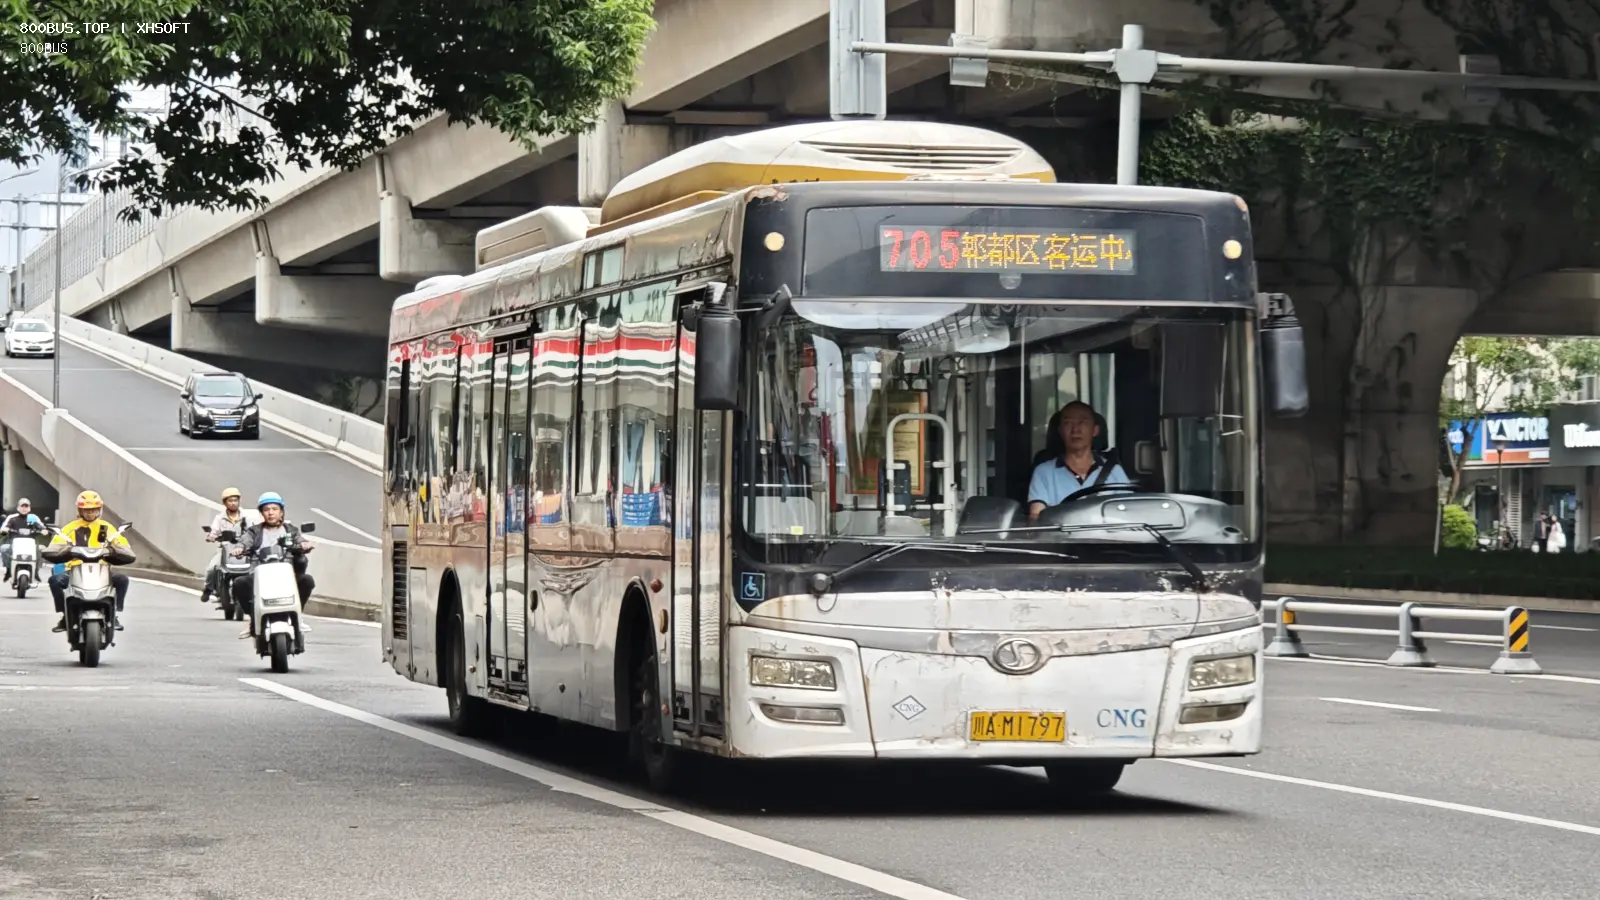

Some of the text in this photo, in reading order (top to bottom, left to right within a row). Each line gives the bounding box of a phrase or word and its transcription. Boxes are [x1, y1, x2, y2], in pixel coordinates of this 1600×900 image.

[883, 229, 960, 269] 705
[899, 703, 919, 713] CNG
[1096, 708, 1147, 728] CNG
